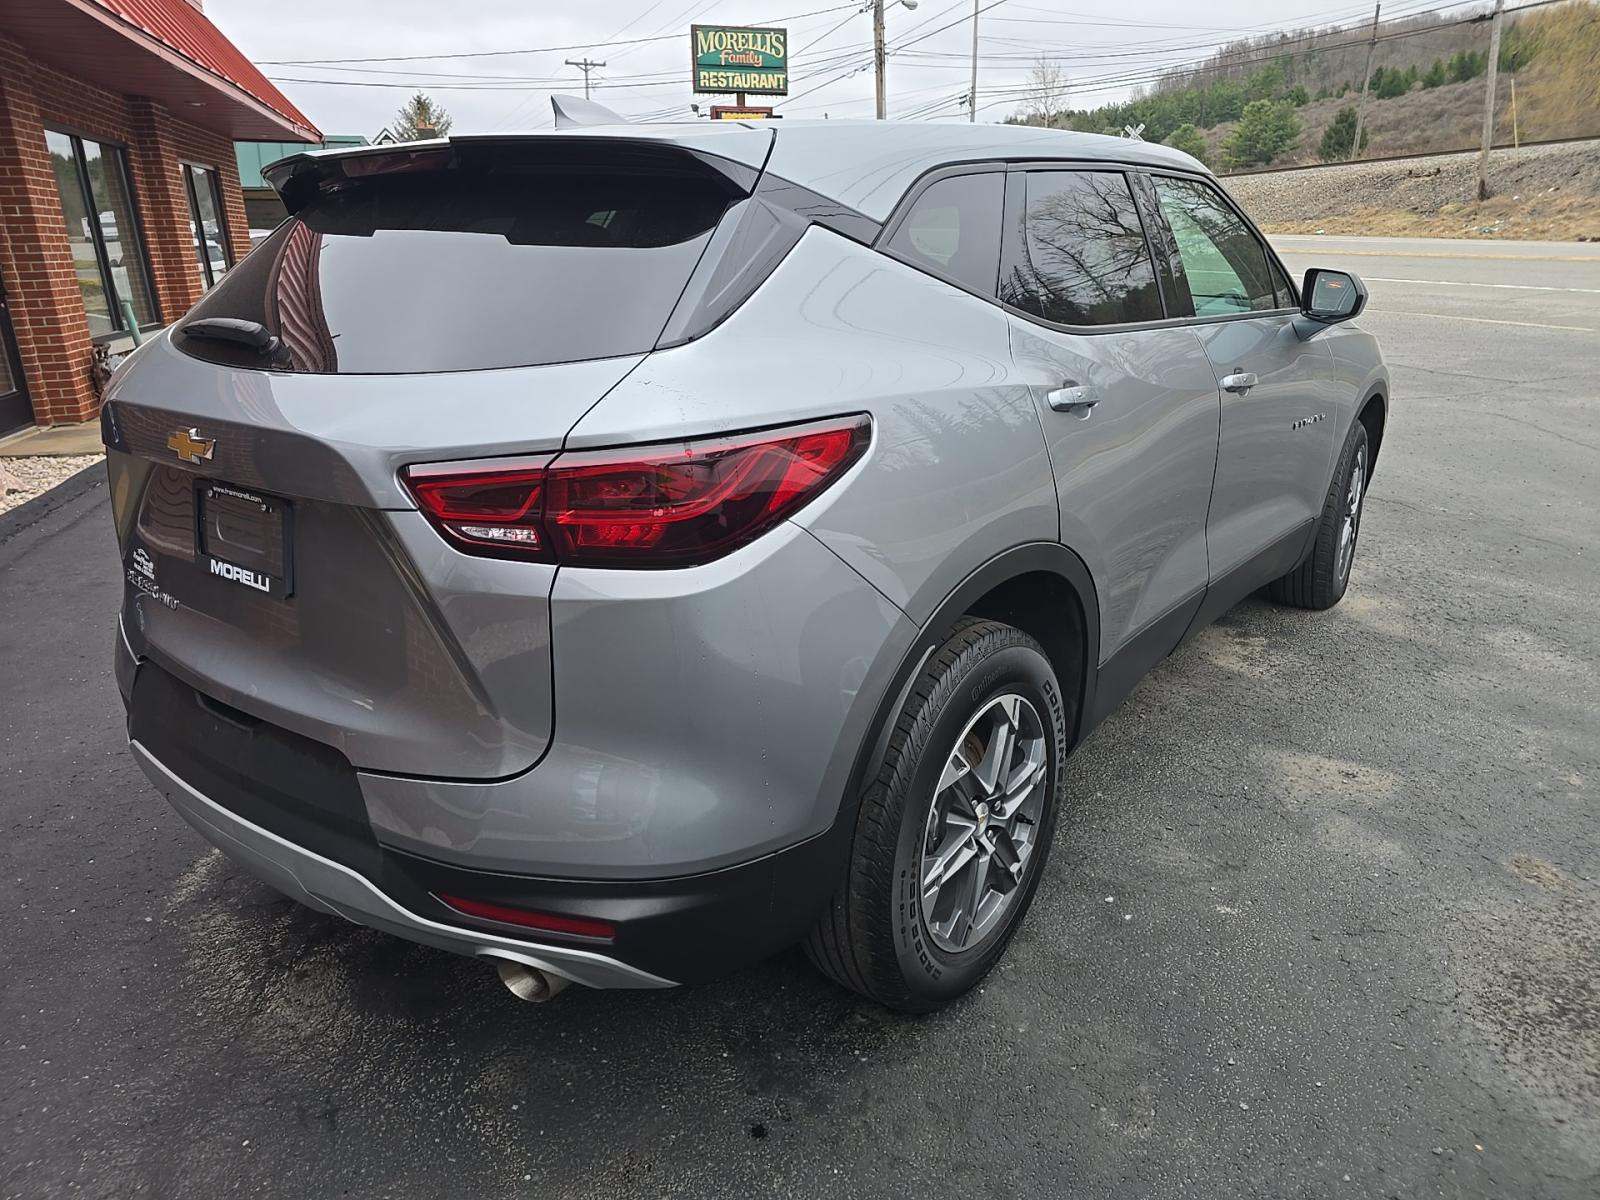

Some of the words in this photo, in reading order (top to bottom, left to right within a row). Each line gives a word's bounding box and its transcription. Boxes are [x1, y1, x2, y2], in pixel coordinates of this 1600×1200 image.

[720, 50, 763, 67] Family
[699, 71, 786, 89] RESTAURANT
[210, 558, 270, 593] MORELLI
